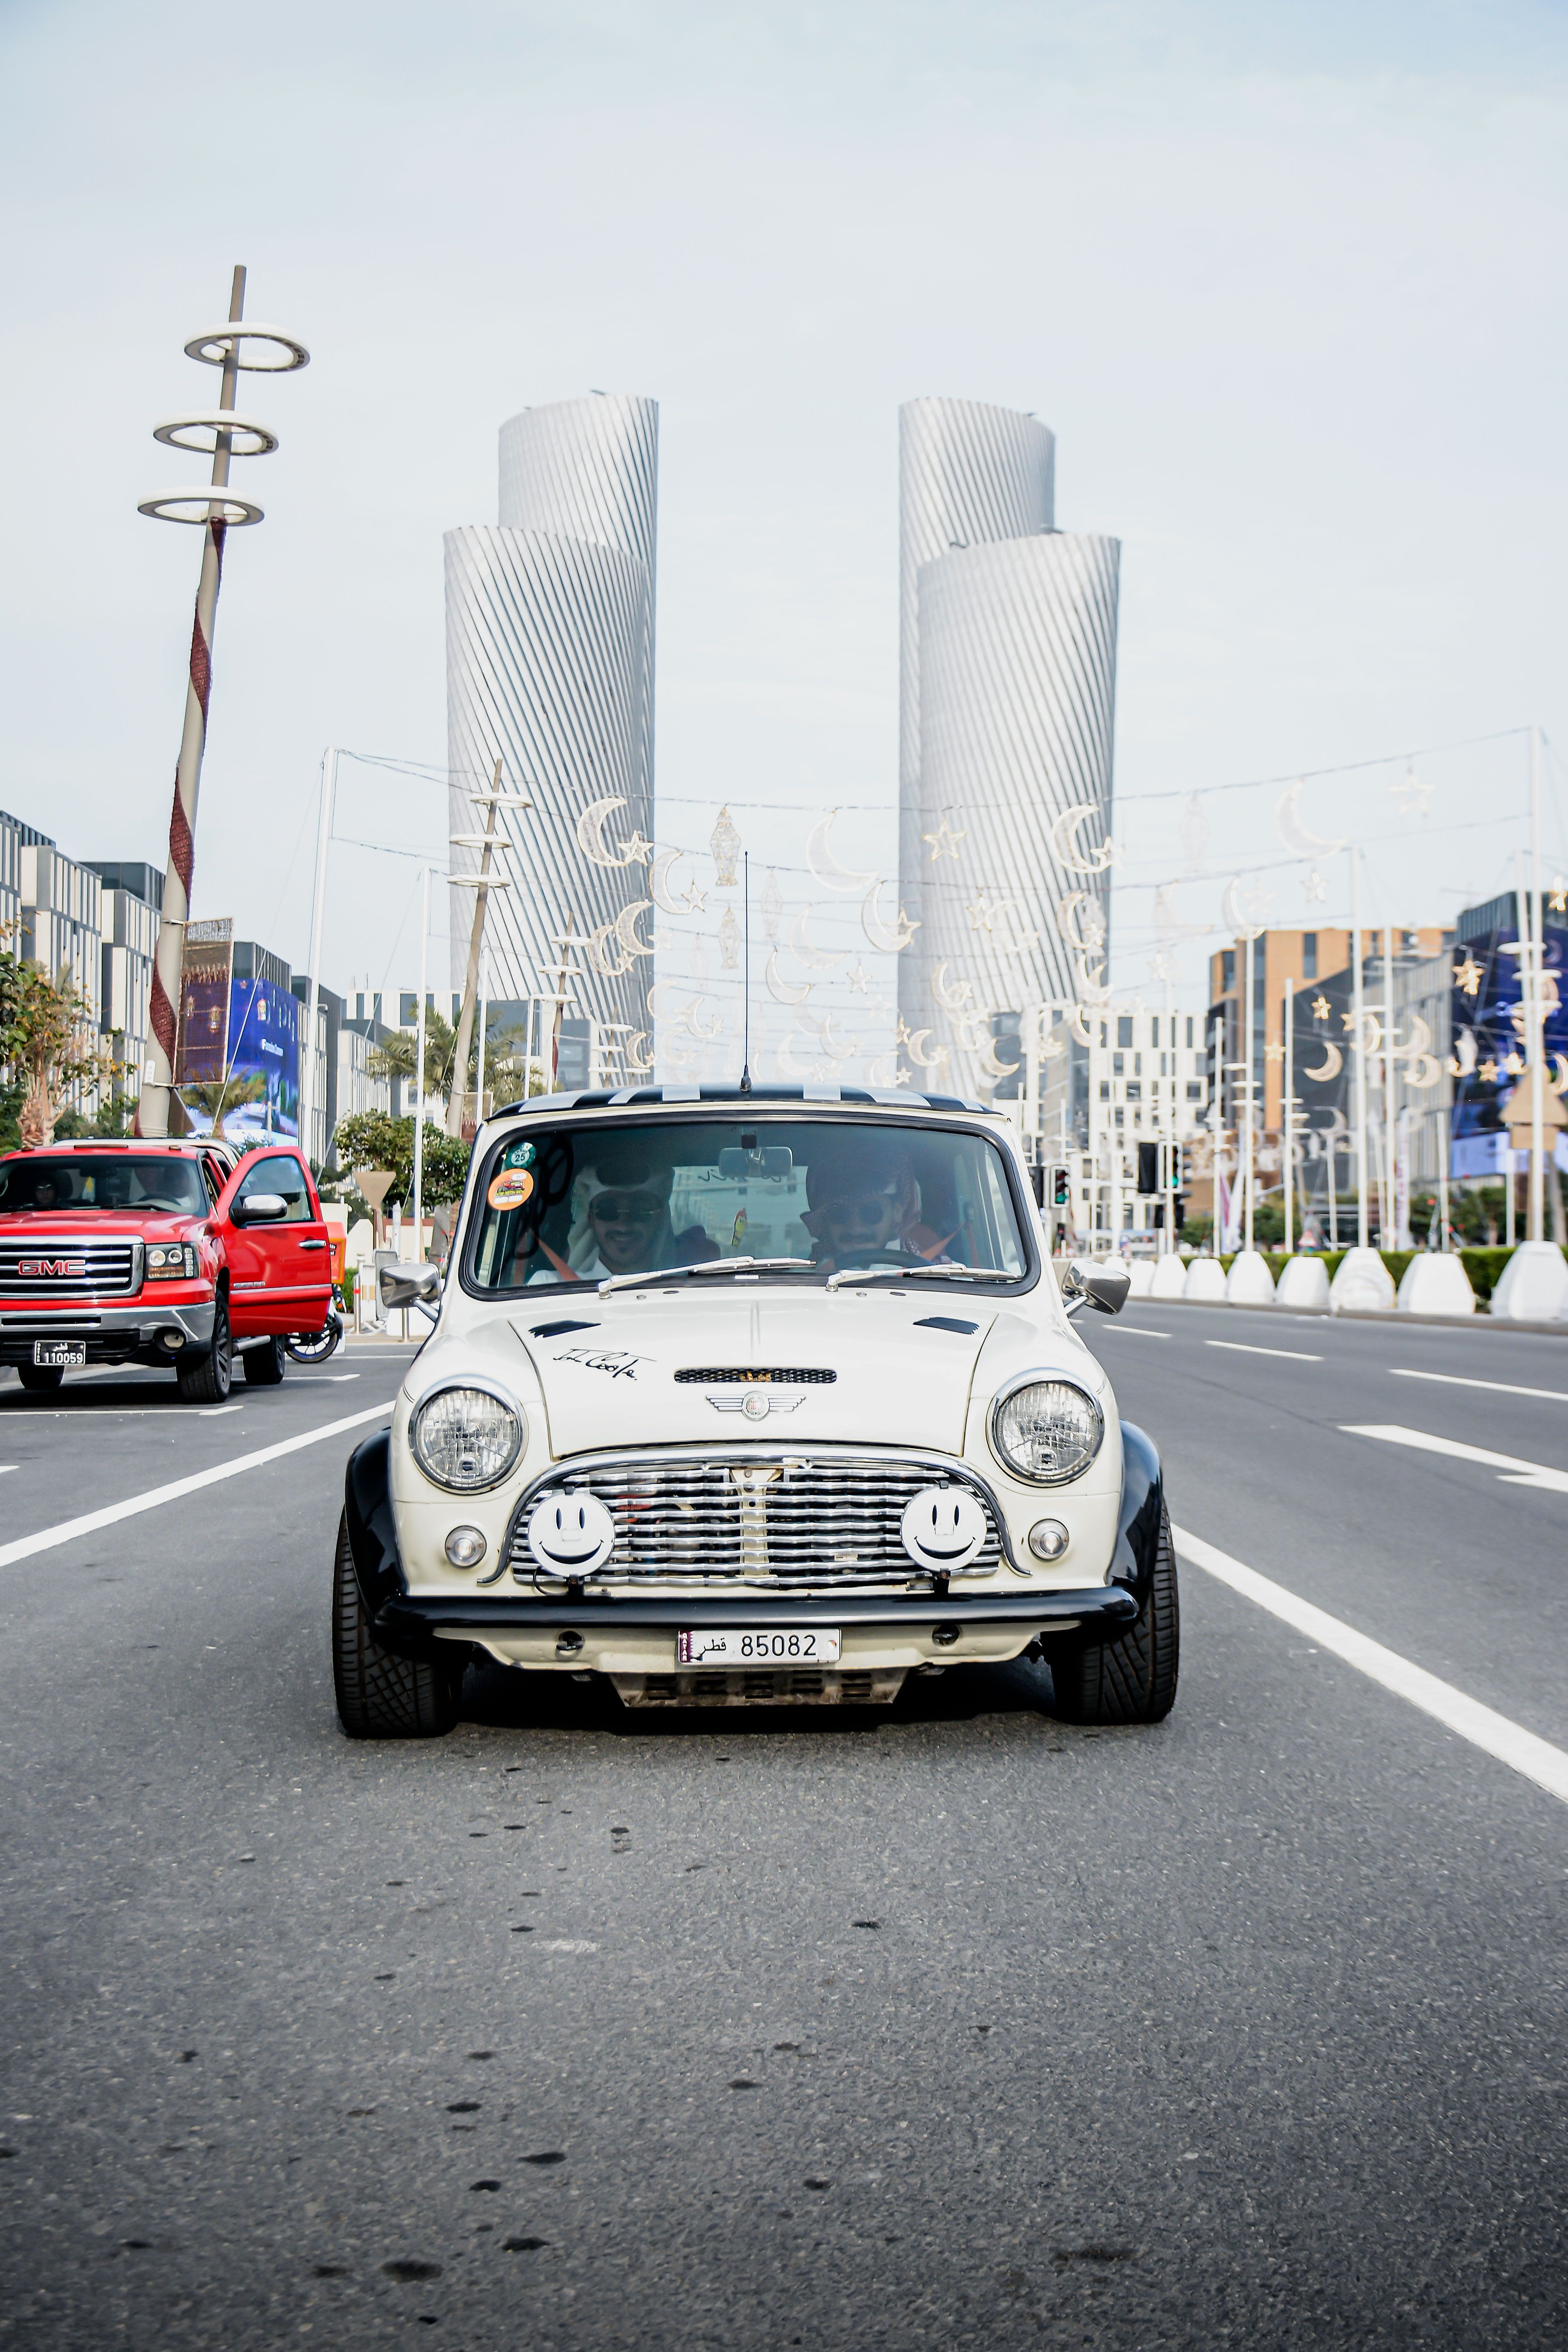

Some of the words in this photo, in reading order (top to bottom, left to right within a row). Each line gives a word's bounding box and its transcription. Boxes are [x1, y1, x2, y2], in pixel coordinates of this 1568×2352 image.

[515, 1153, 525, 1162] 25
[19, 1260, 86, 1275] GMC
[52, 1343, 68, 1351] قطر
[45, 1352, 83, 1363] 110059
[691, 1638, 726, 1661] قطر
[741, 1635, 816, 1657] 85082
